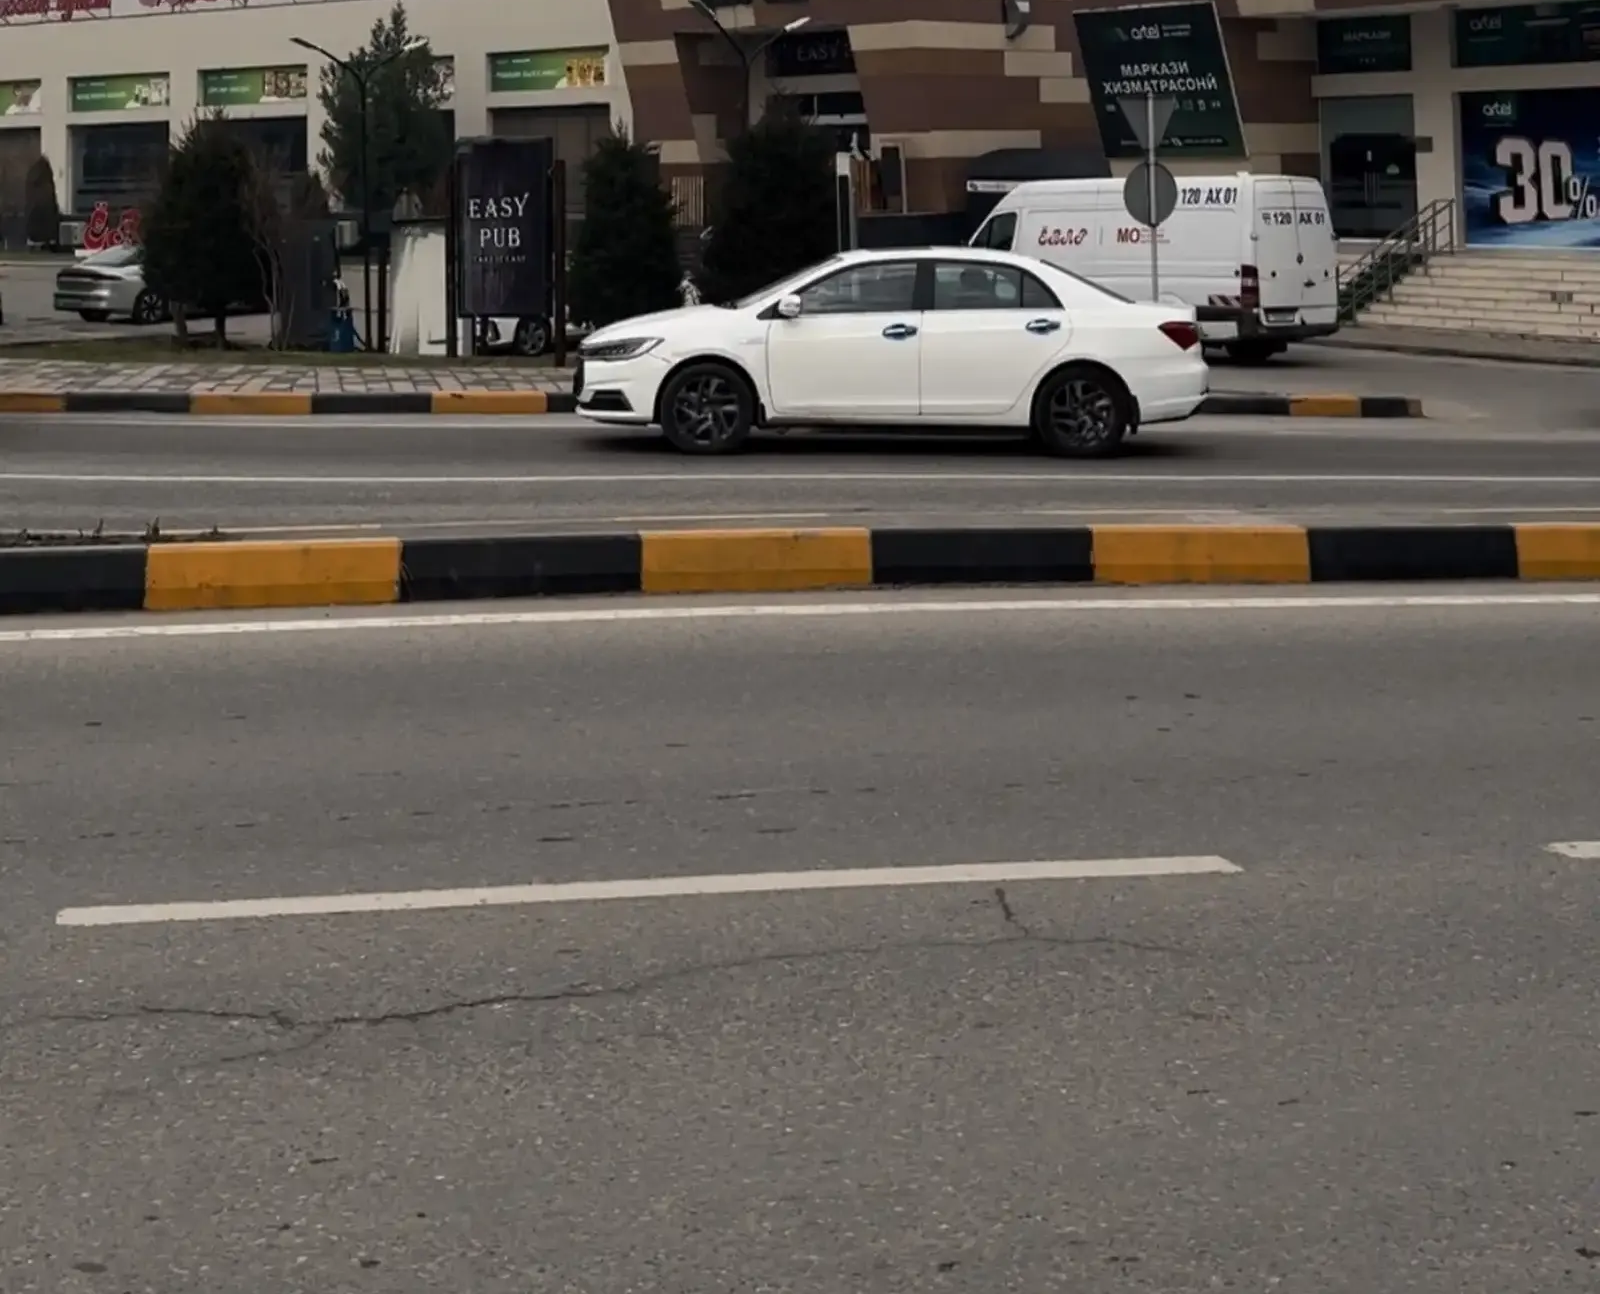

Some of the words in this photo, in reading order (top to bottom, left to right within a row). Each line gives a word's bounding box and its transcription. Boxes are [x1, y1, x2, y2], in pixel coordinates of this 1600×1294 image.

[1120, 60, 1189, 78] МАРКАЗИ
[1496, 137, 1597, 224] 30%
[469, 192, 529, 218] EASY
[1181, 188, 1201, 205] 120
[1224, 188, 1238, 205] 01
[1273, 212, 1292, 225] 120
[480, 227, 521, 248] PUB
